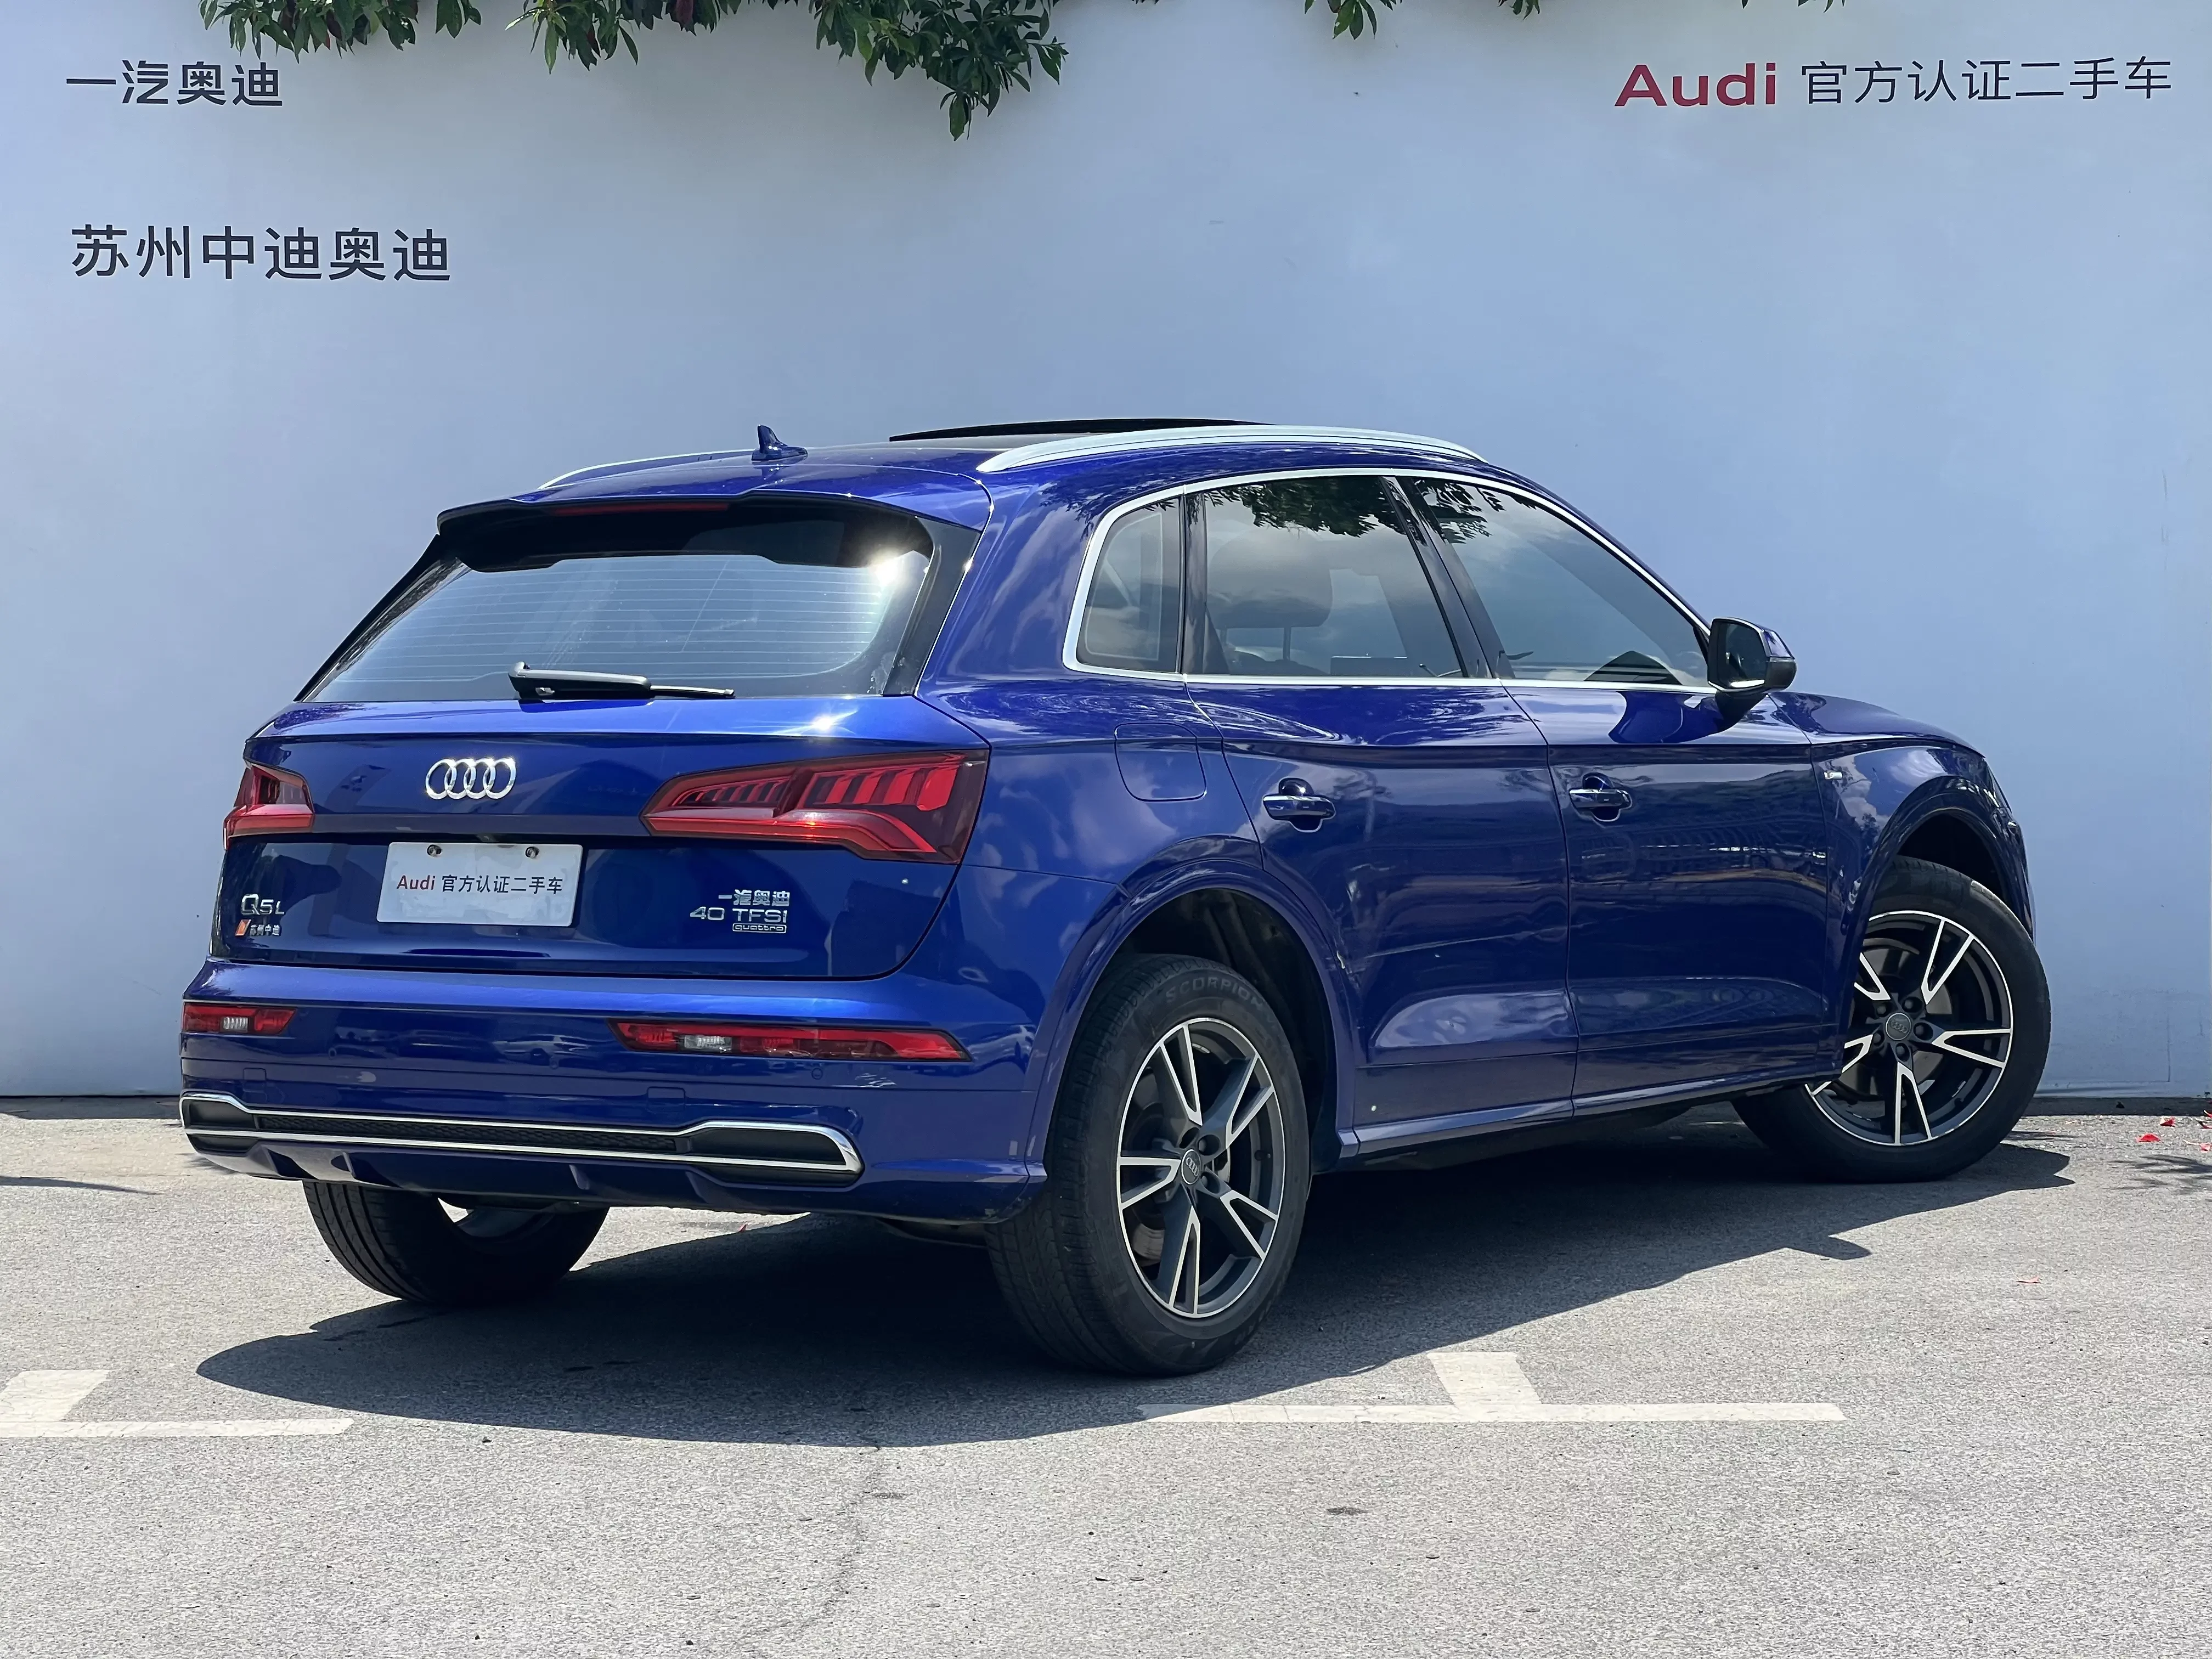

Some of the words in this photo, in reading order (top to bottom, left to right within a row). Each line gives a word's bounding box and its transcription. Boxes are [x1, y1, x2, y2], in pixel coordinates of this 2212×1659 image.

[66, 60, 283, 106] 一汽奥迪
[1615, 63, 1776, 106] Audi
[1802, 55, 2171, 104] 官方认证二手车
[72, 224, 450, 281] 苏州中迪奥迪
[397, 875, 436, 890] Audi
[441, 874, 563, 894] 官方认证二手车
[718, 889, 790, 906] 一汽奥迪
[241, 894, 284, 915] Q5L
[690, 906, 725, 921] 40
[732, 908, 788, 923] TFSI
[1165, 977, 1265, 1011] SCORPION
